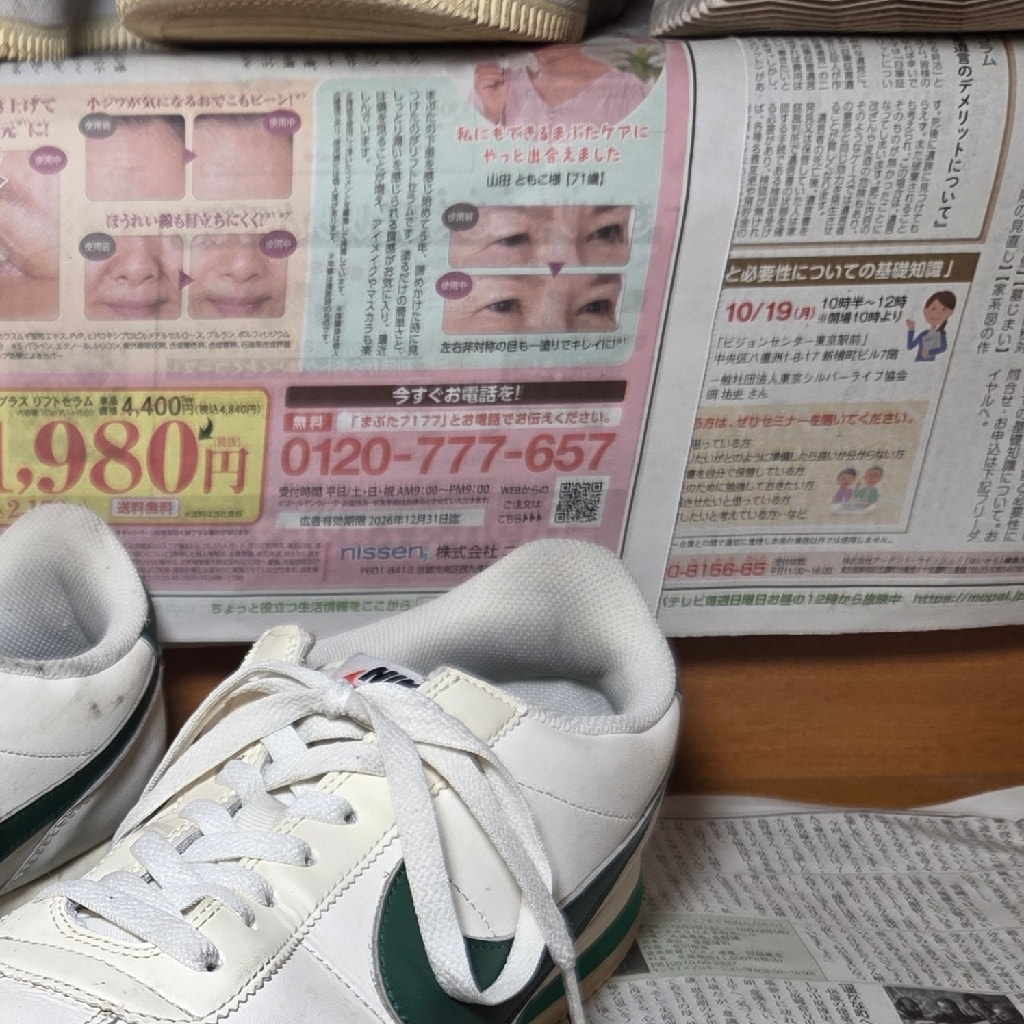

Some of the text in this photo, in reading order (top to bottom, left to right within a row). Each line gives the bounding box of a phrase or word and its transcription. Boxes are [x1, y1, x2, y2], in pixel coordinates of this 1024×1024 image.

[482, 147, 623, 165] やっと出会えました
[486, 174, 511, 187] 山田
[292, 415, 323, 429] 無料
[279, 432, 617, 476] 0120-777-657
[278, 485, 323, 498] 受付時間
[500, 484, 550, 496] WEBからの
[116, 500, 176, 515] 送料無料
[299, 514, 365, 527] 広告有効期限
[340, 543, 426, 562] nissen
[436, 544, 498, 561] 株式会社
